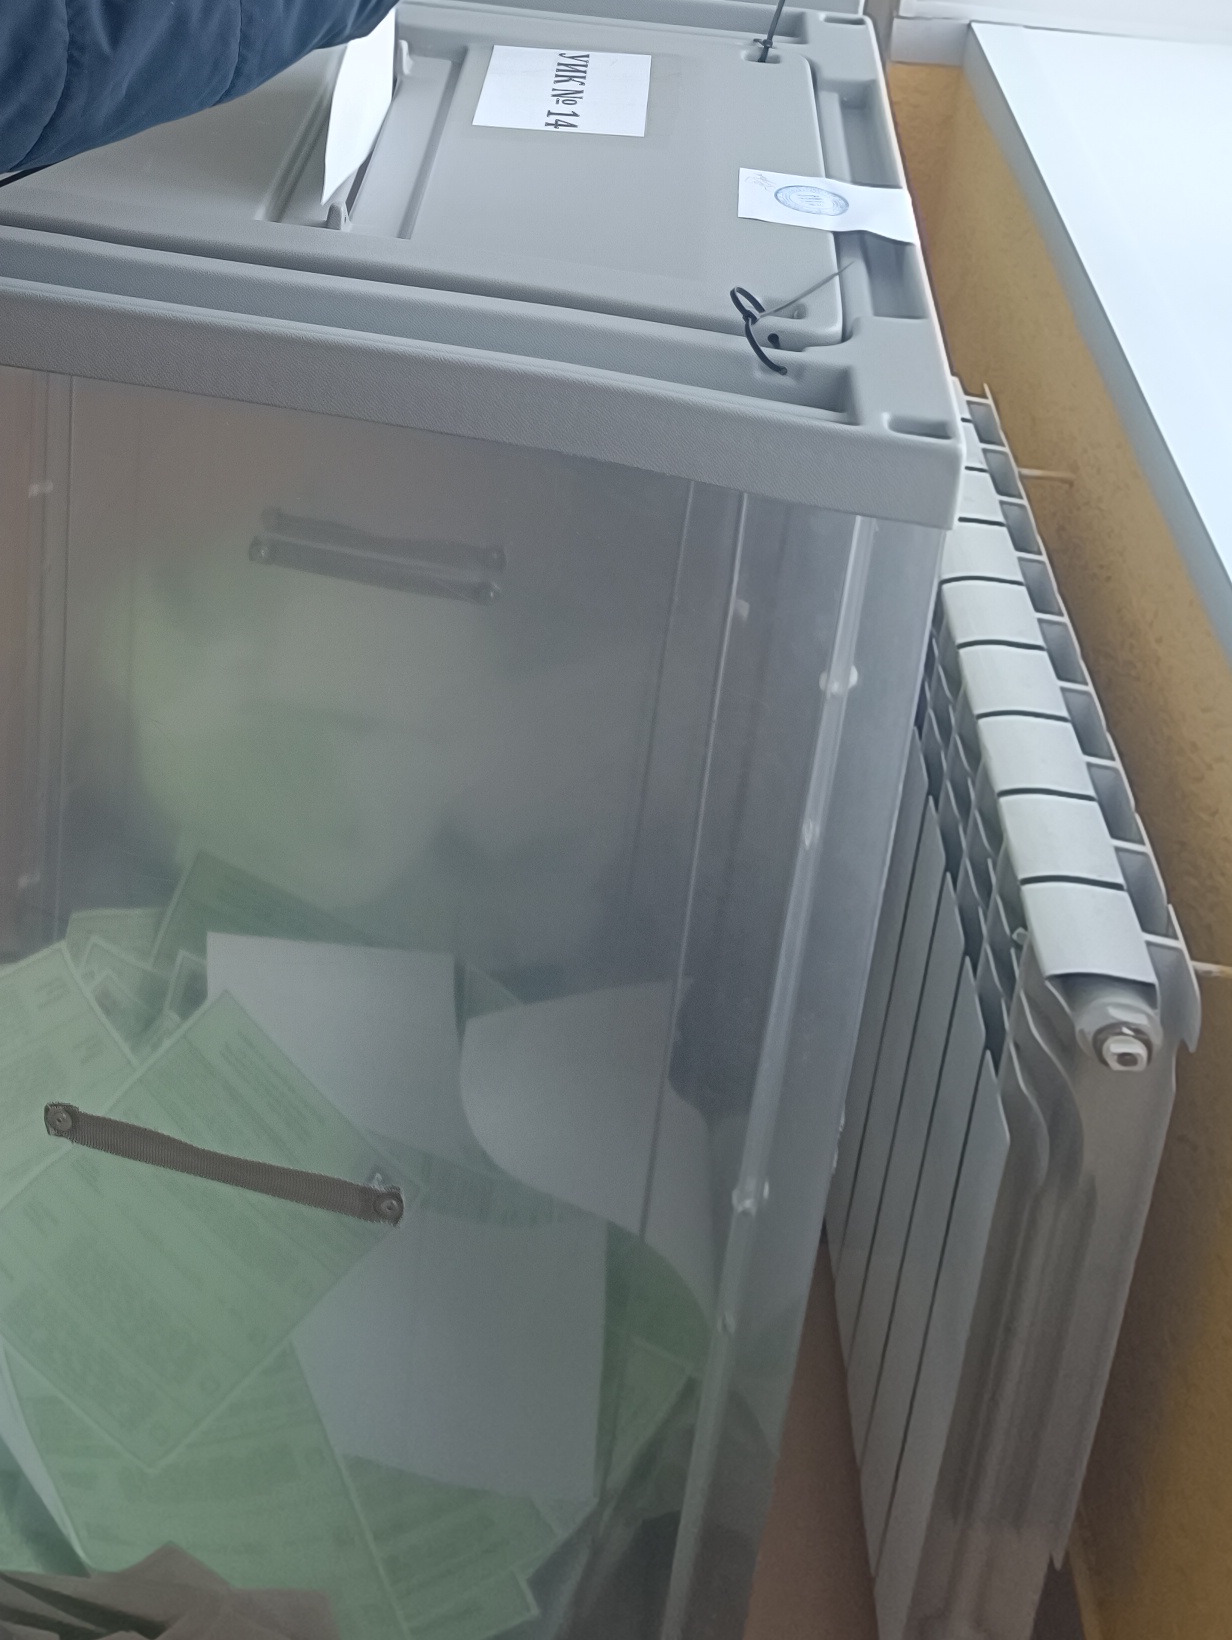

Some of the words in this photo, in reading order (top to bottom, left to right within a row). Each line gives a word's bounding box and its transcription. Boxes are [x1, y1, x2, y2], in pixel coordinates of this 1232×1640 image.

[553, 52, 590, 86] УИК
[551, 87, 584, 106] №
[544, 109, 580, 130] 14
